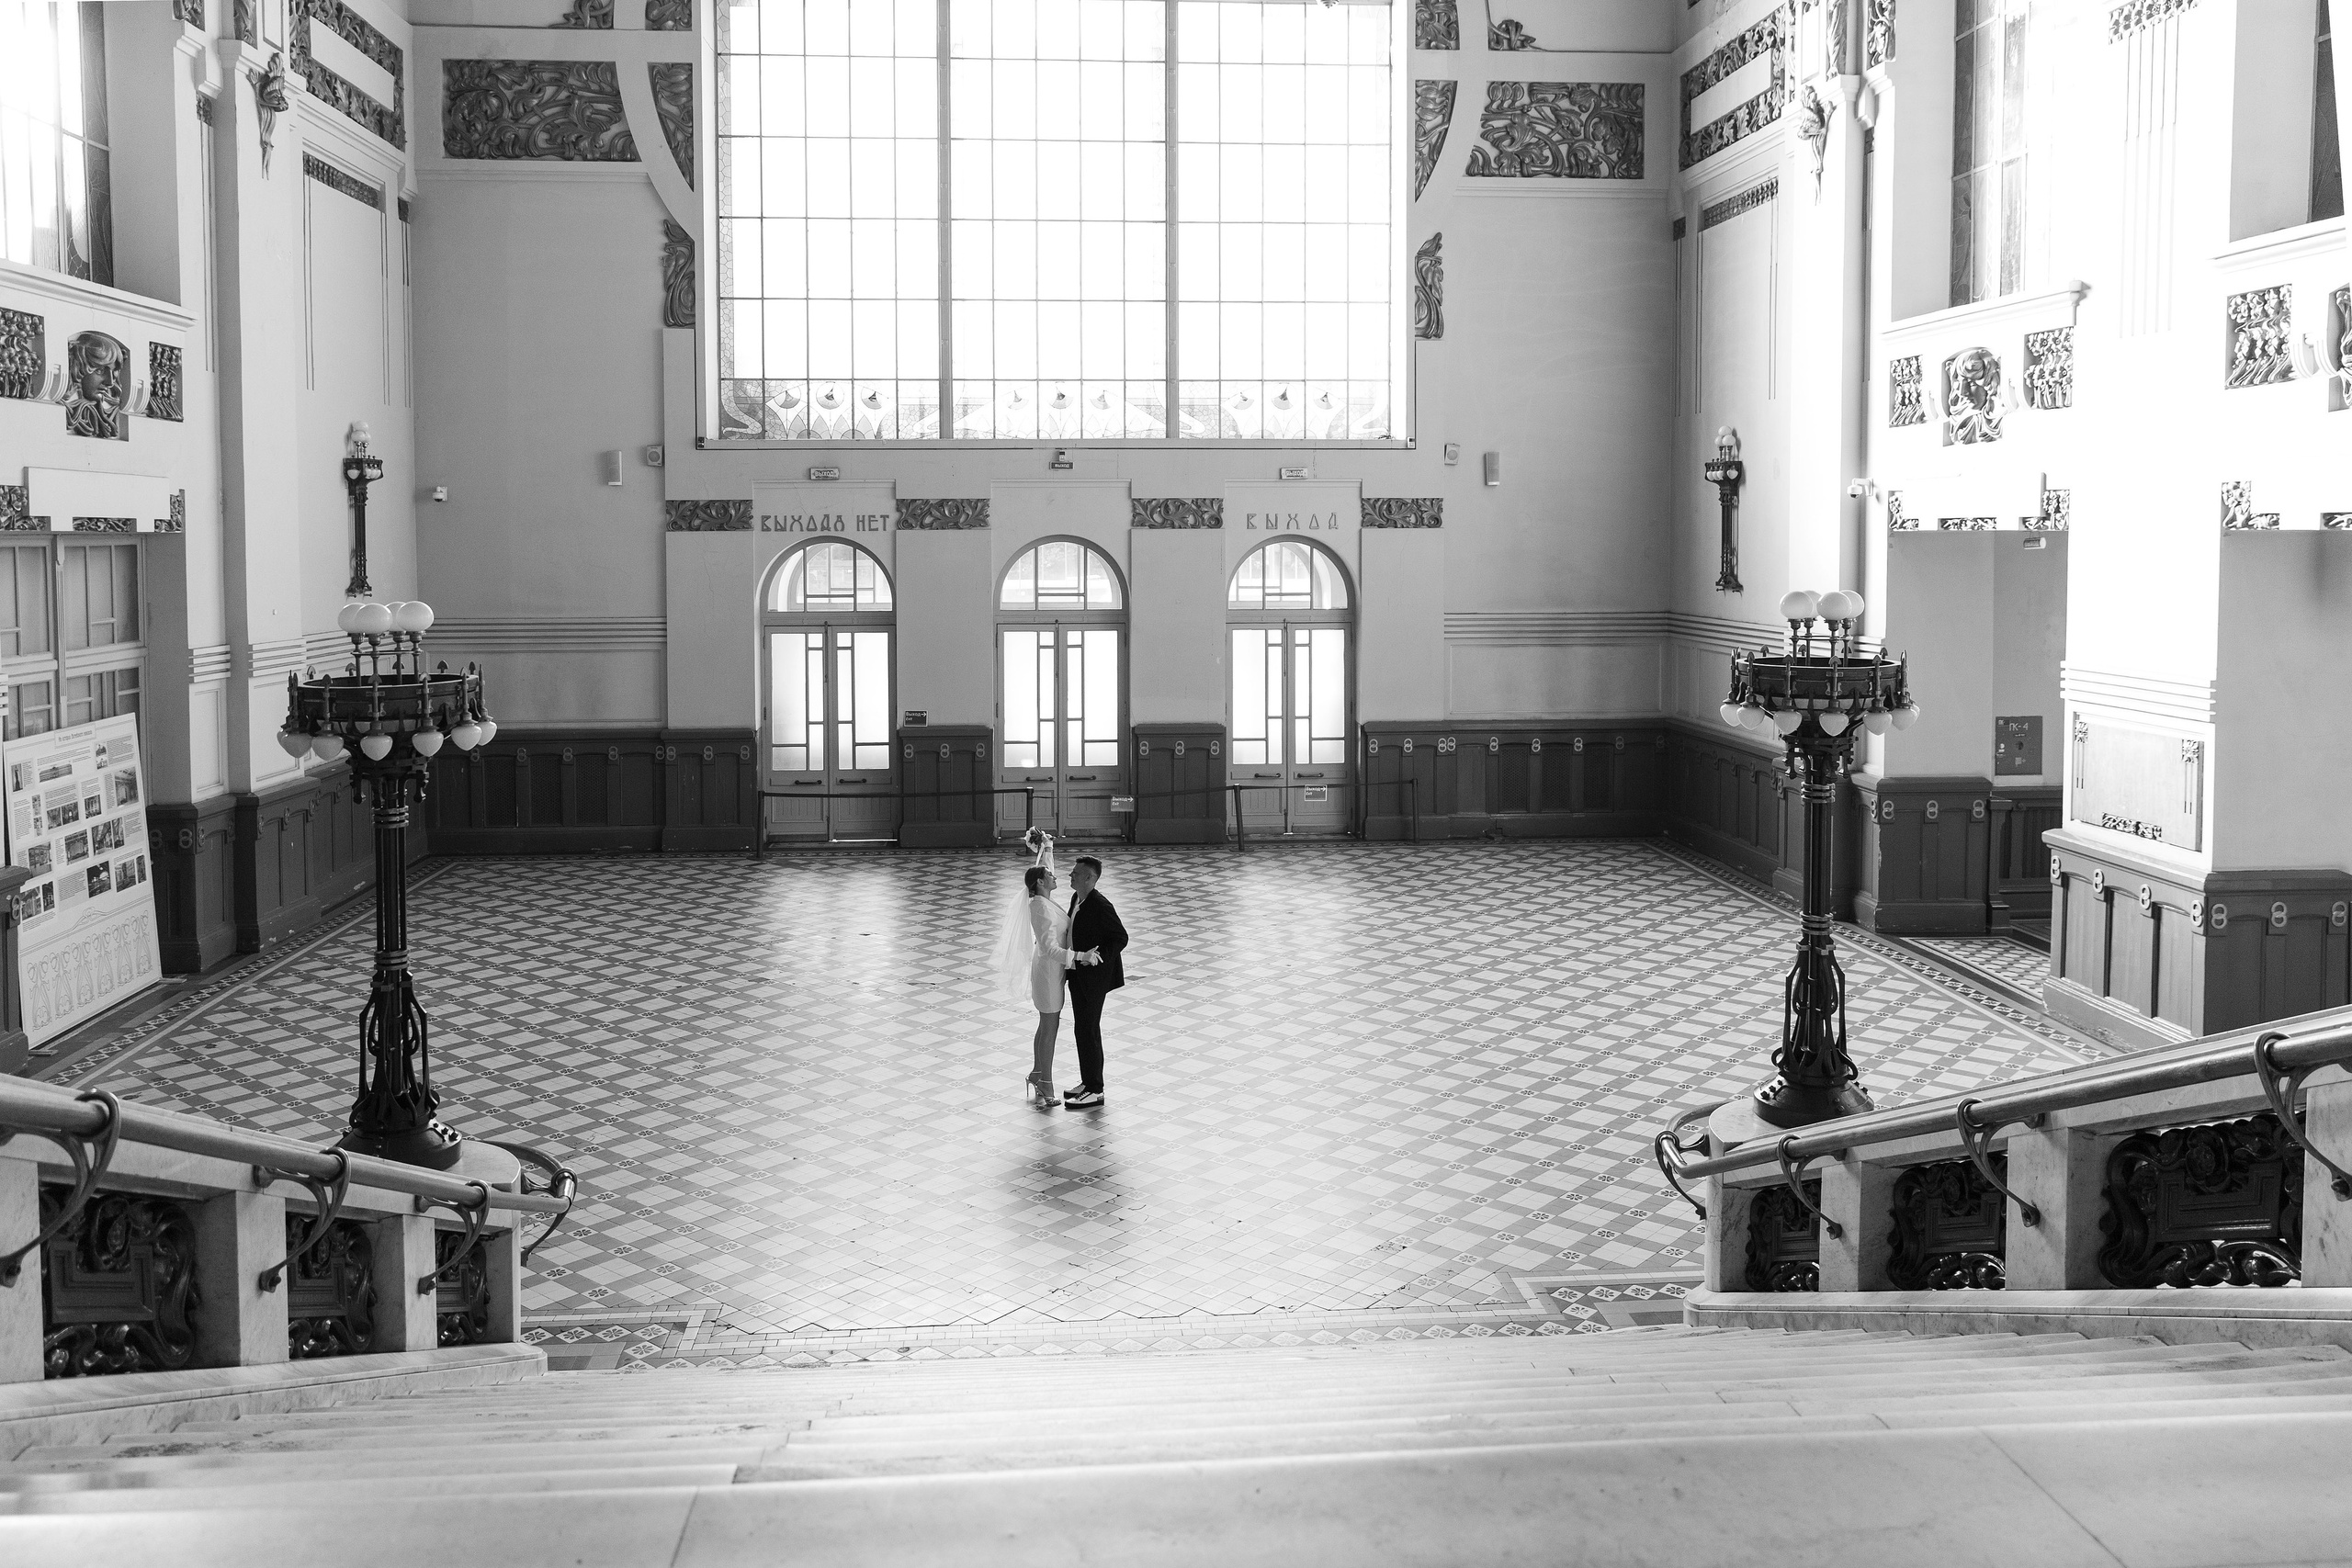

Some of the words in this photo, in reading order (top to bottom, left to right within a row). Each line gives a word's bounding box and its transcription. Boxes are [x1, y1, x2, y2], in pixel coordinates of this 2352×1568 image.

[761, 514, 845, 532] ВЫХОДА
[856, 514, 889, 532] НЕТ
[1246, 513, 1339, 530] ВЫХОД
